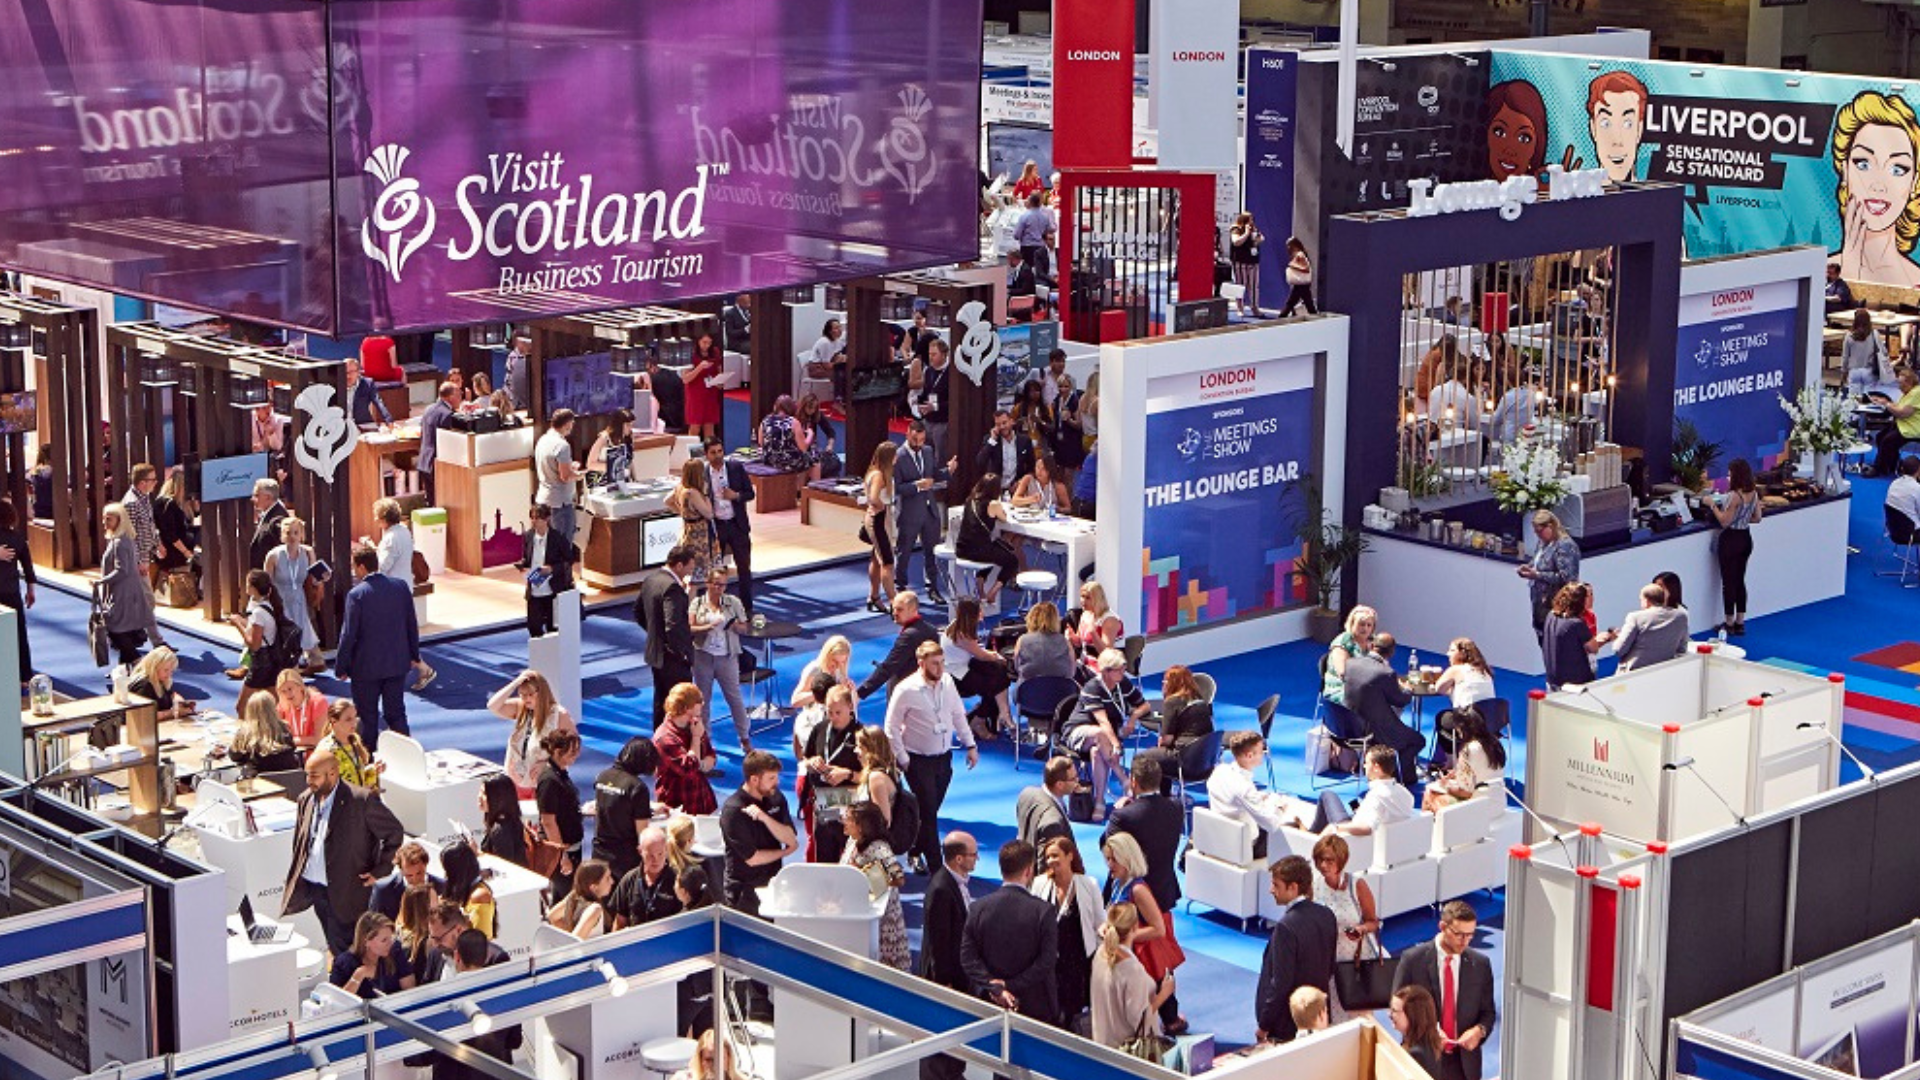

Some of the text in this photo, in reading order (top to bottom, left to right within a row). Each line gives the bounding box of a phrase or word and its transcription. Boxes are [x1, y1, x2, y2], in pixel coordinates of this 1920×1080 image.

[1068, 50, 1120, 61] LONDON
[1173, 51, 1225, 62] LONDON
[1646, 104, 1814, 145] LIVERPOOL
[1666, 145, 1764, 167] SENSATIONAL
[488, 152, 565, 194] Visit
[1666, 161, 1764, 182] AS STANDARD
[447, 165, 708, 260] Scotland
[500, 250, 703, 294] Business Tourism
[1711, 288, 1755, 307] LONDON
[1720, 333, 1768, 352] MEETINGS
[1720, 351, 1749, 367] SHOW
[1200, 368, 1256, 388] LONDON
[1674, 369, 1784, 406] THE LOUNGE BAR
[1214, 418, 1278, 442] MEETINGS
[1213, 438, 1253, 459] SHOW
[1144, 460, 1299, 507] THE LOUNGE BAR
[1567, 758, 1634, 785] MILLENNIUM
